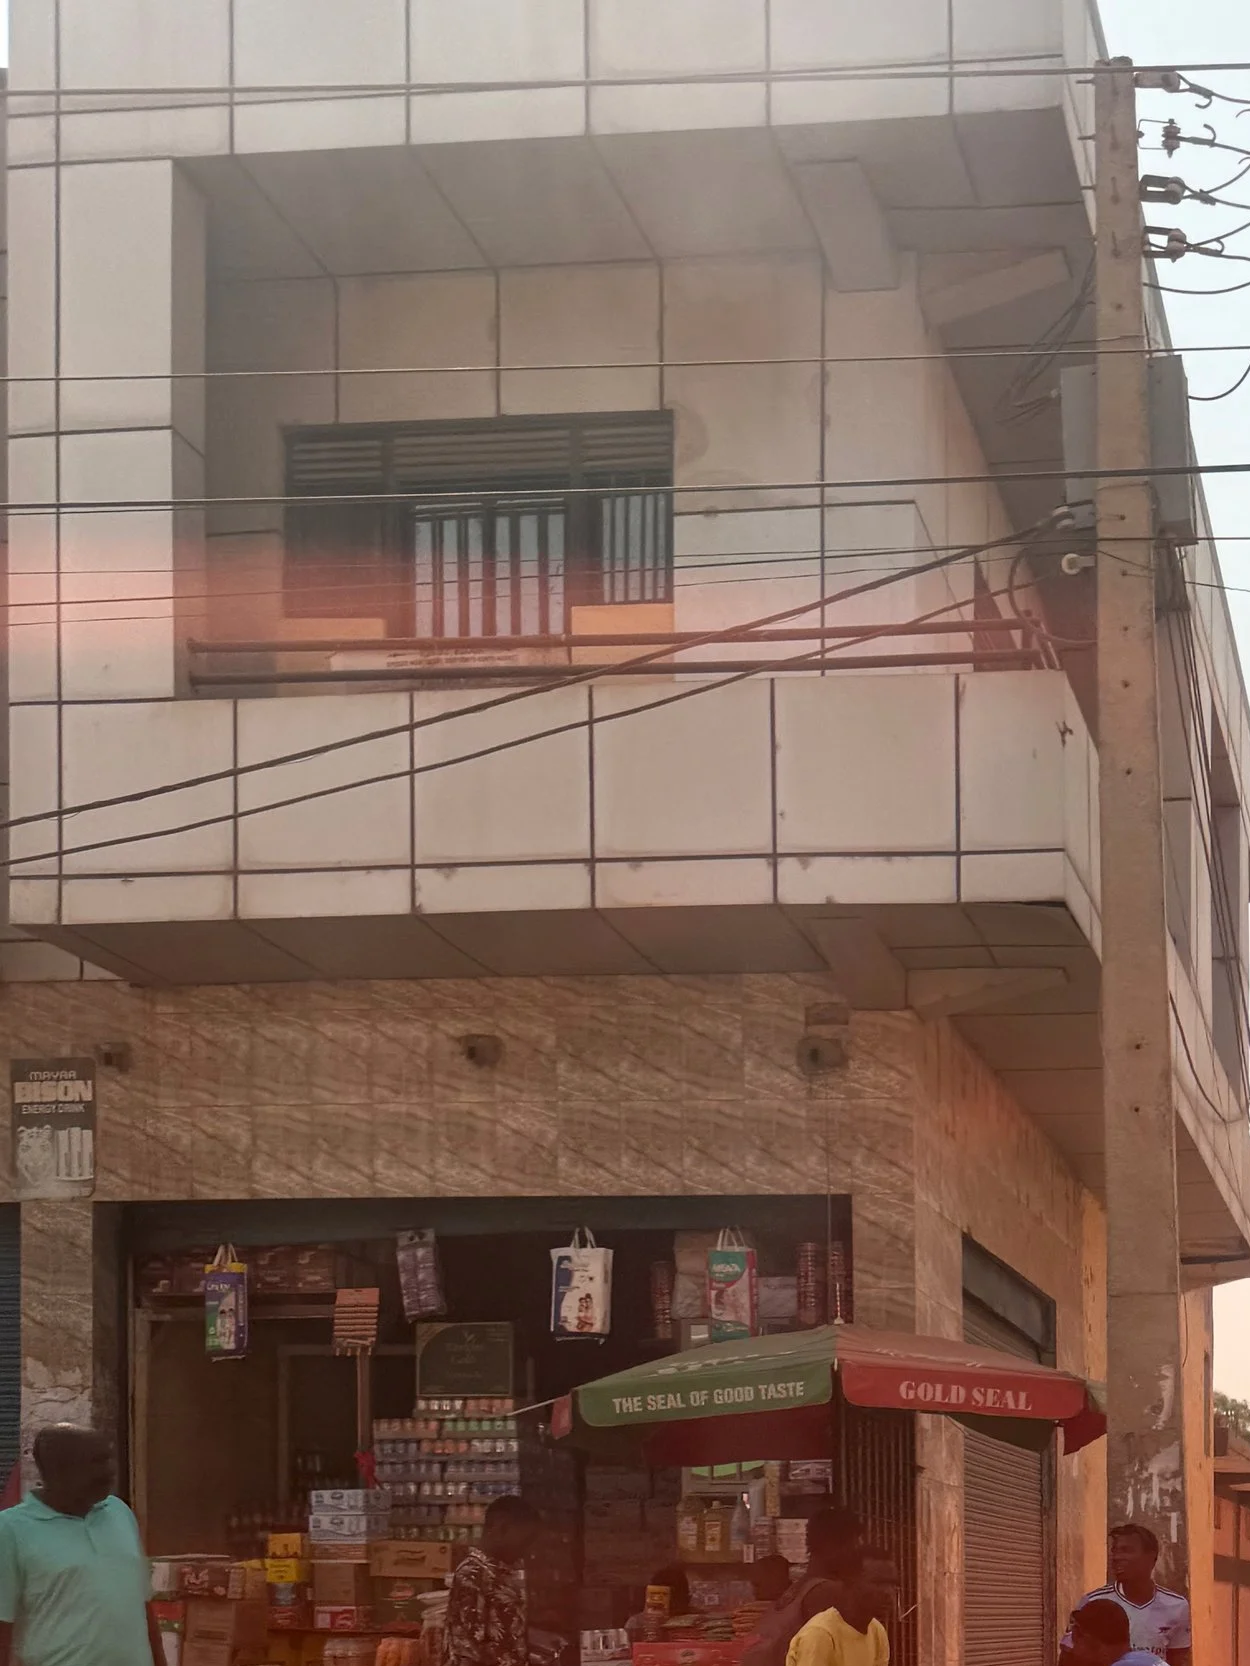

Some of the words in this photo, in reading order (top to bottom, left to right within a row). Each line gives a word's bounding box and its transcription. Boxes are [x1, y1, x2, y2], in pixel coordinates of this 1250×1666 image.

[14, 1080, 93, 1103] BISON
[21, 1103, 56, 1114] ENERGY
[612, 1398, 643, 1414] THE
[647, 1391, 686, 1412] SEAL
[690, 1390, 709, 1407] OF
[713, 1385, 755, 1405] GOOD
[758, 1381, 805, 1400] TASTE
[900, 1380, 966, 1405] GOLD
[971, 1387, 1033, 1411] SEAL
